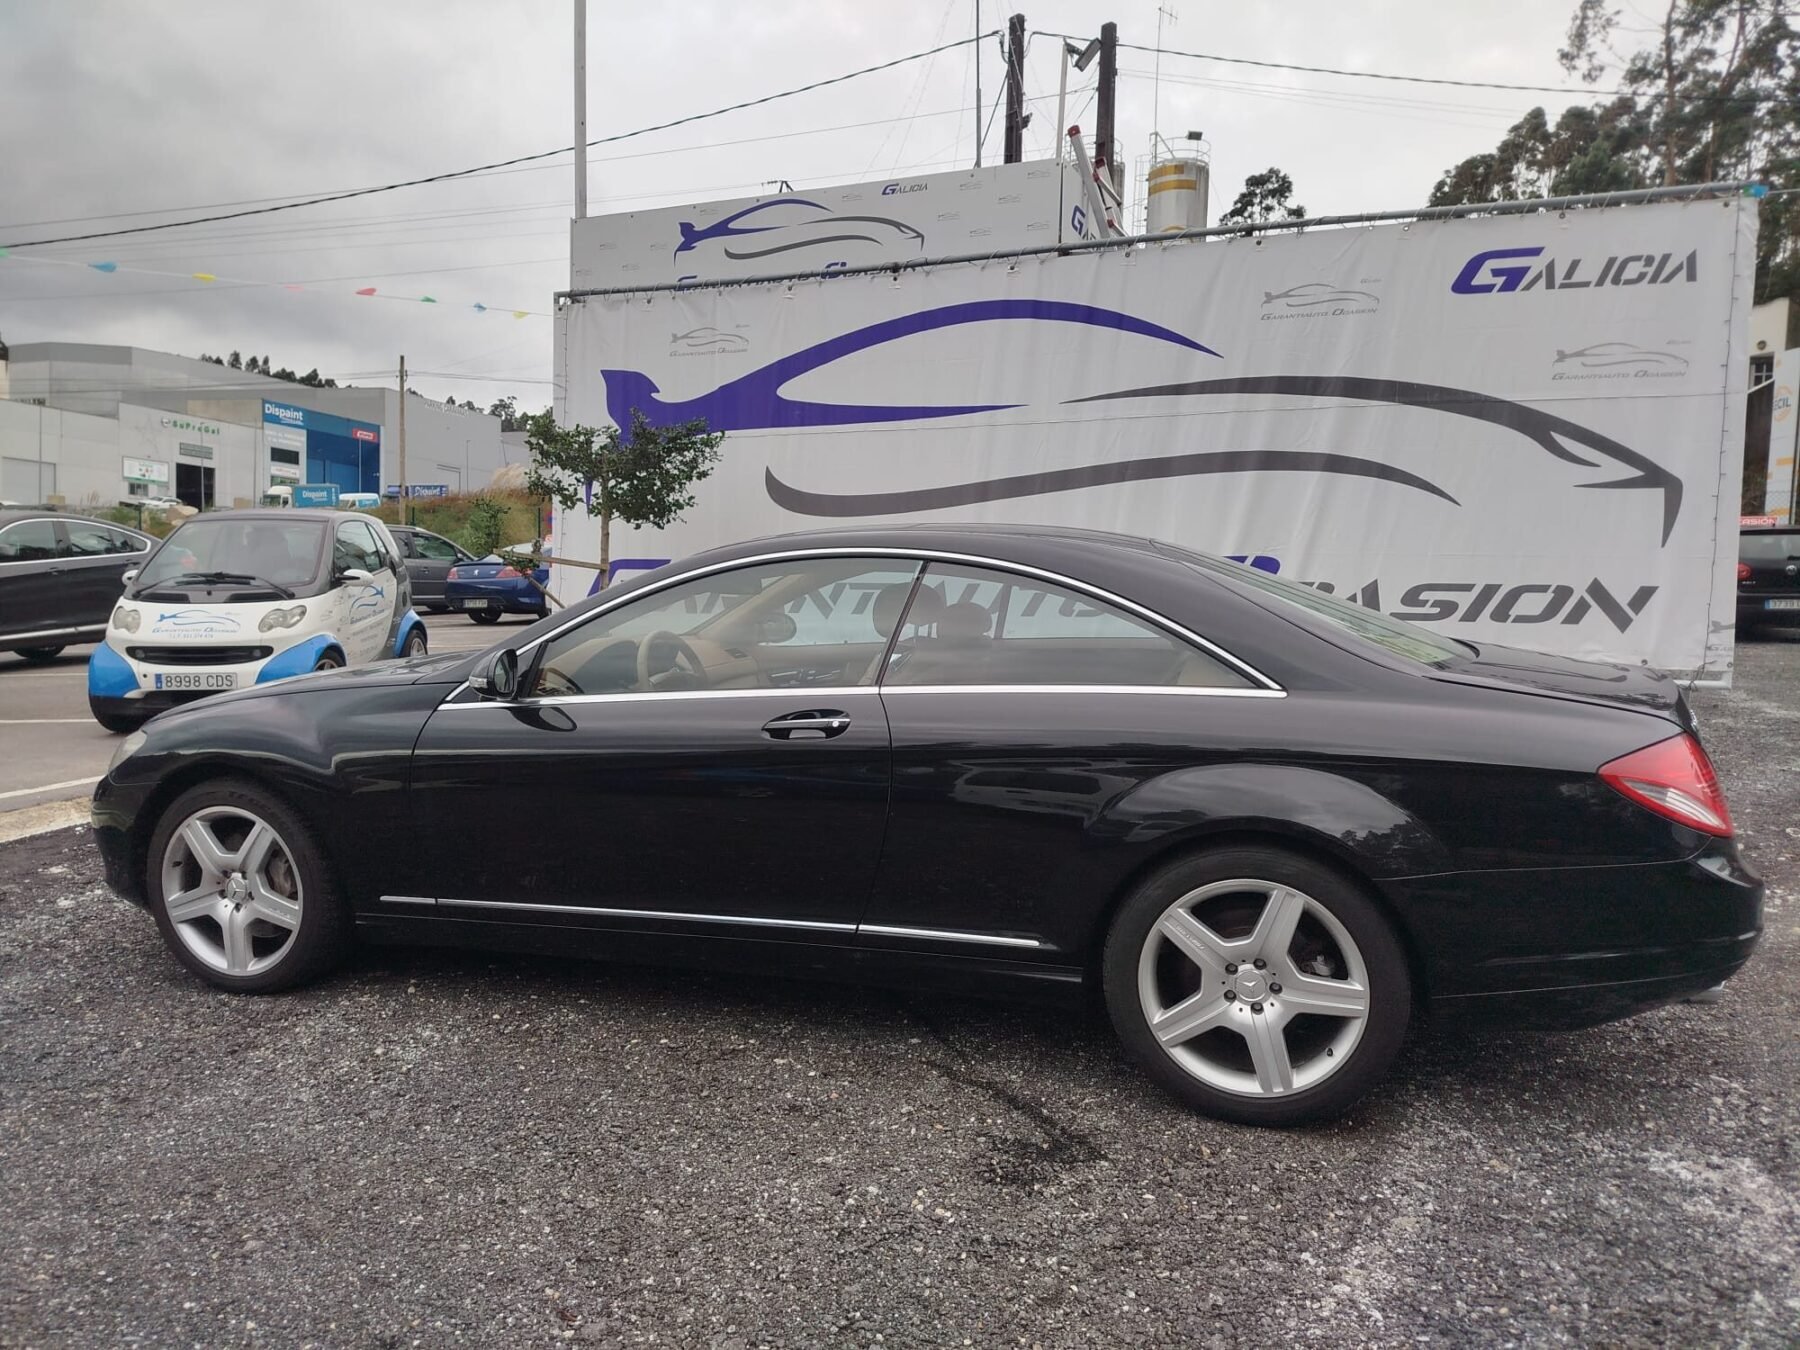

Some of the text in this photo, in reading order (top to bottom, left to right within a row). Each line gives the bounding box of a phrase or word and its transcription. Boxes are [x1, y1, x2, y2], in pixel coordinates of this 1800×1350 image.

[881, 182, 928, 196] GALICIA
[1451, 246, 1697, 294] GALICIA
[265, 403, 304, 421] Dispaint
[165, 674, 233, 688] 8998 CDS
